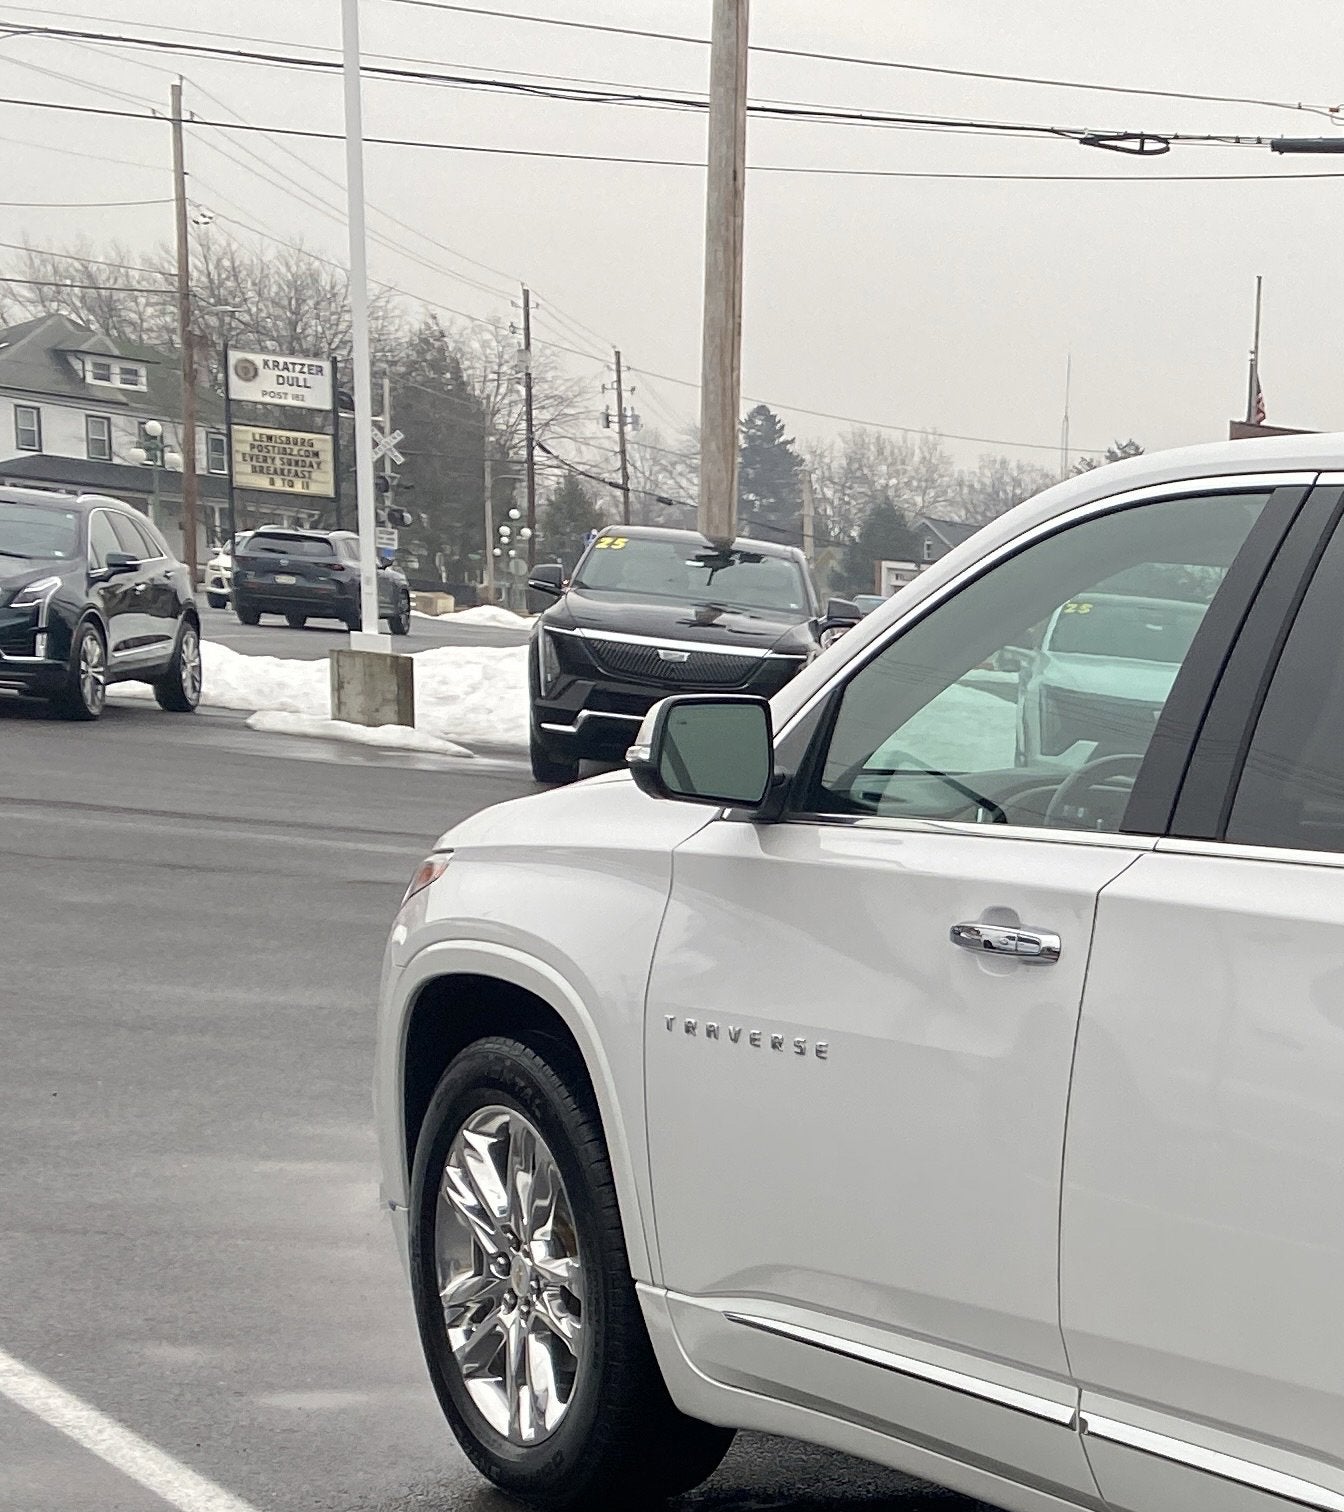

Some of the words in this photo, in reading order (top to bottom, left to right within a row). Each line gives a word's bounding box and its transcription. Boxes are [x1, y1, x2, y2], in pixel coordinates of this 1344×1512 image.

[262, 358, 324, 376] KRATZER
[276, 374, 311, 389] DULL
[261, 389, 288, 400] POST
[252, 432, 314, 448] LEWISBURG
[241, 452, 276, 464] EVERY
[280, 456, 322, 470] SUNDAY
[251, 464, 313, 480] BREAKFAST
[282, 478, 295, 488] TO
[595, 536, 630, 550] 25
[1063, 603, 1094, 614] 25
[663, 1014, 829, 1060] TRAVERSE
